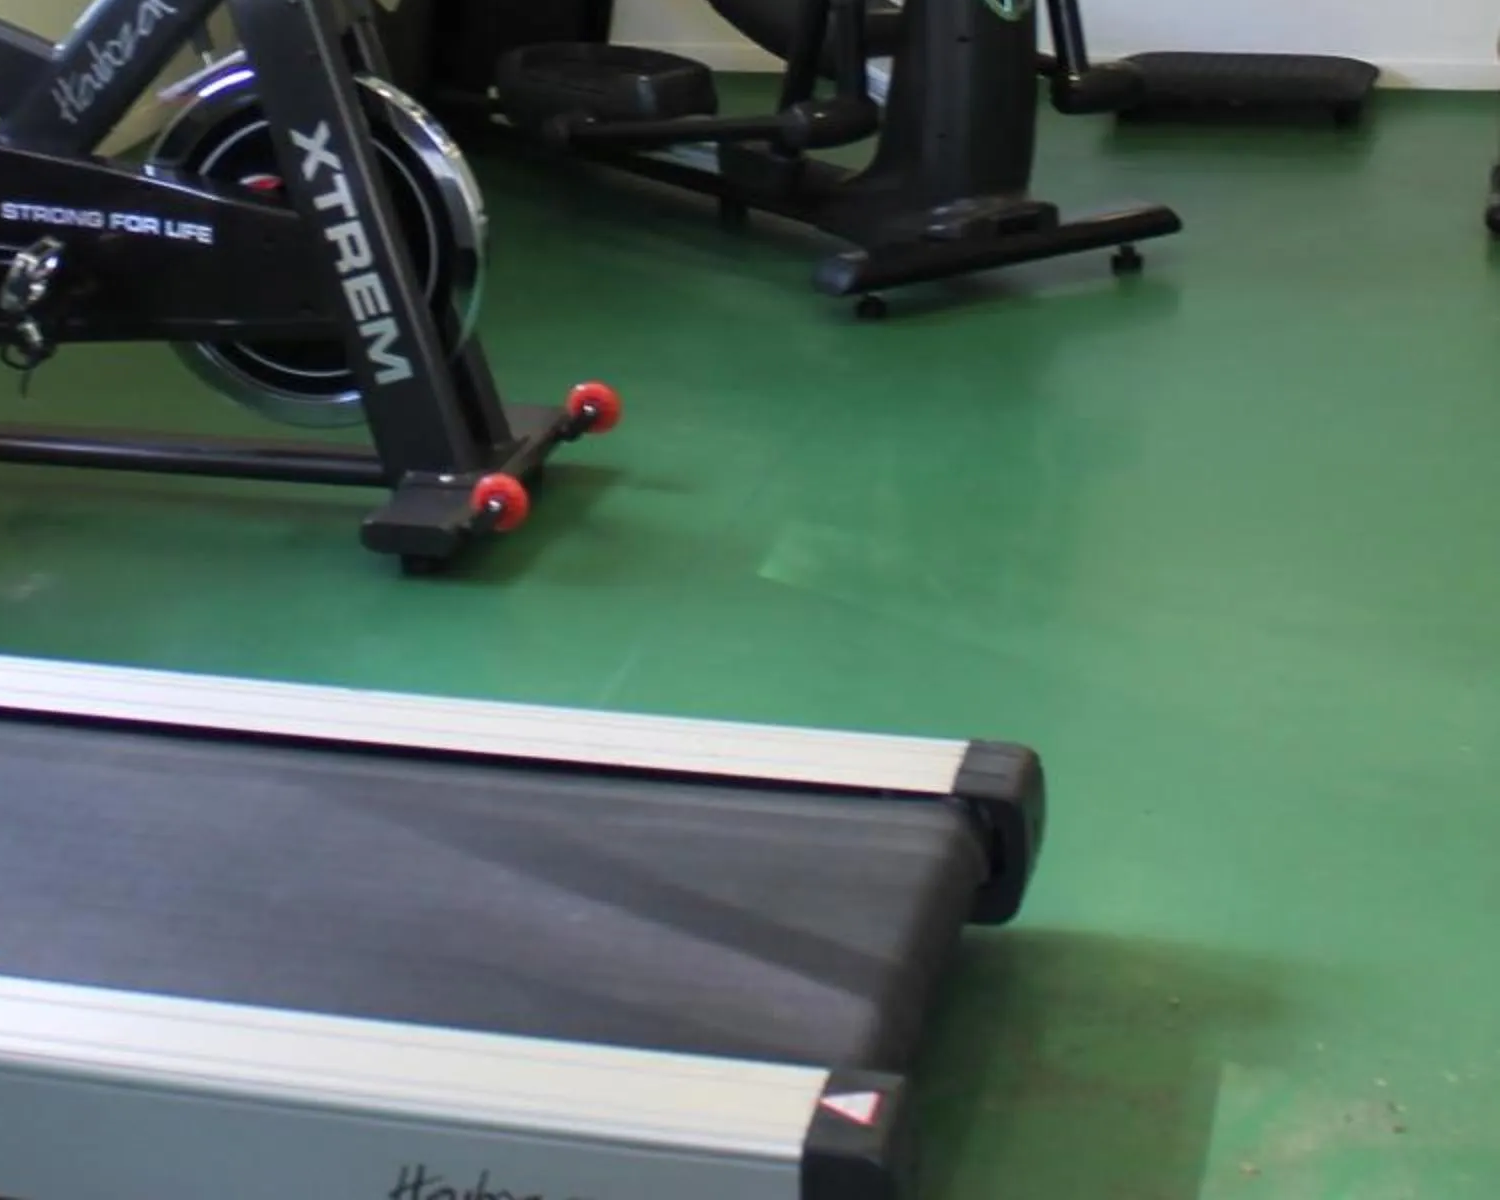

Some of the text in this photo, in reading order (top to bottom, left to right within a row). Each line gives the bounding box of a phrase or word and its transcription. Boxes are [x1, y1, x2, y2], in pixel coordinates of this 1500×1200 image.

[1, 201, 214, 245] STRONG FOR LIFE
[288, 120, 414, 385] XTREM
